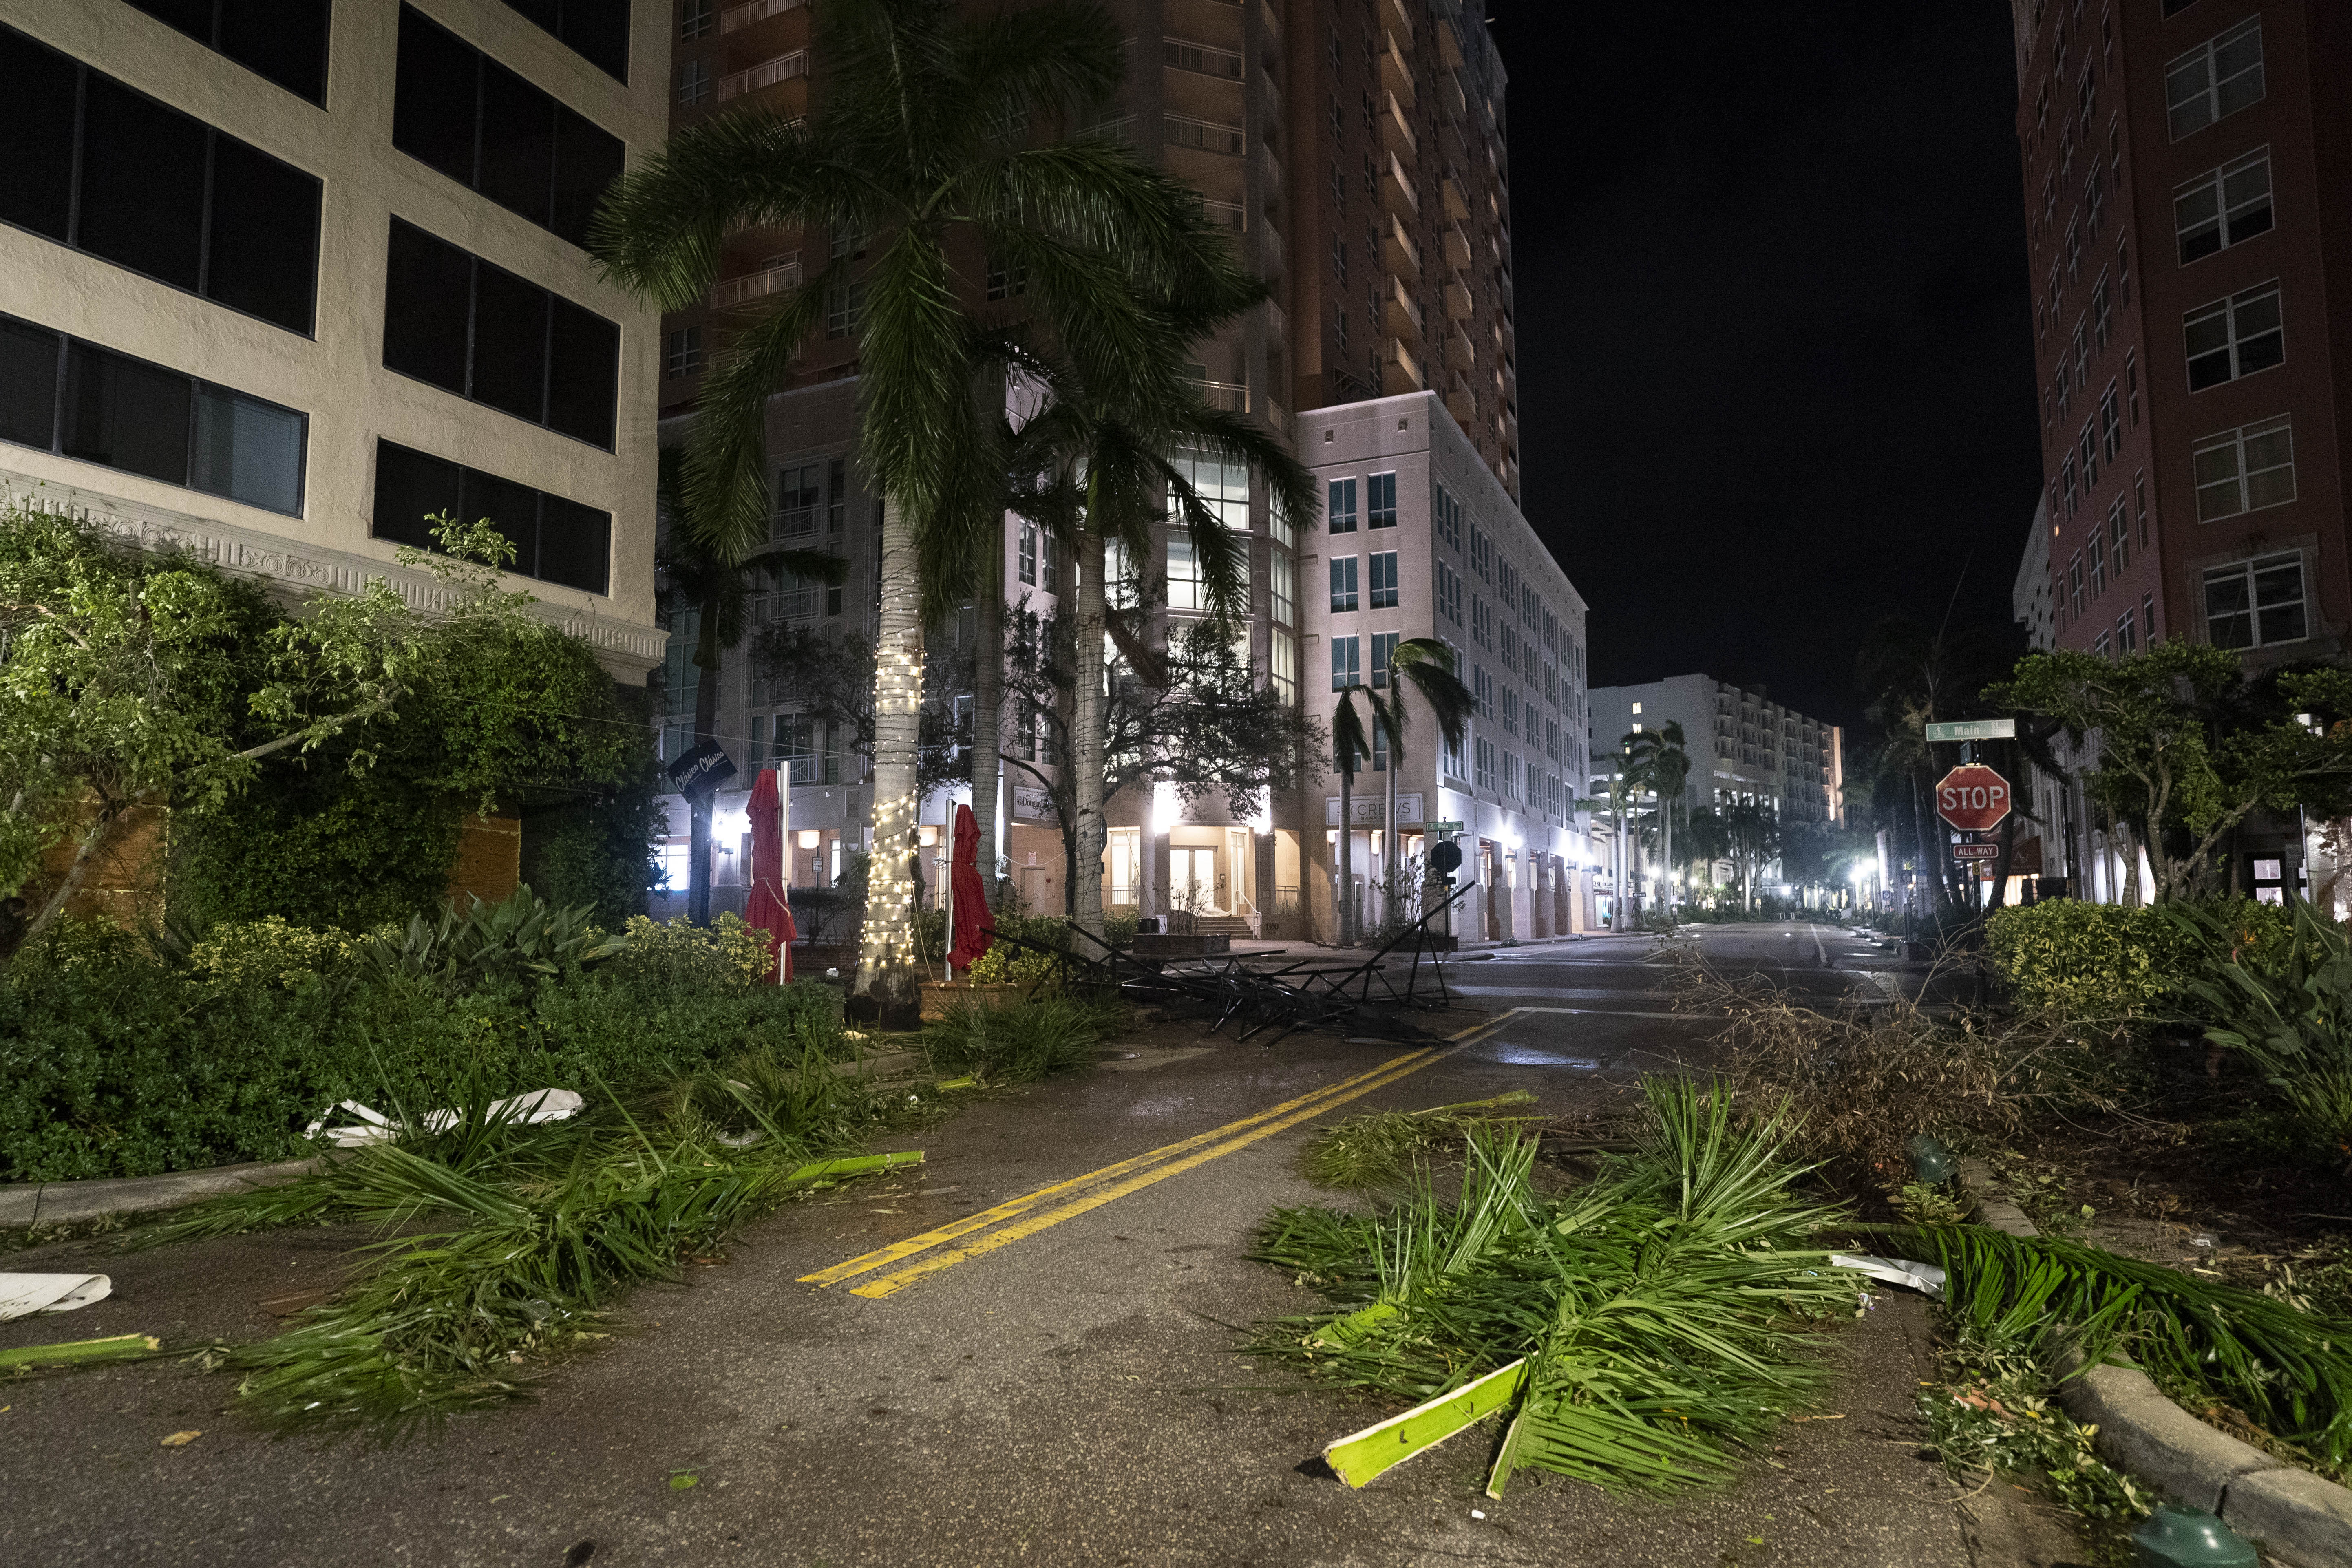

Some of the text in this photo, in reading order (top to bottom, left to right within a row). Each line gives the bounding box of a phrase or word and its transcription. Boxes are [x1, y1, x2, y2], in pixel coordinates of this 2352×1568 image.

[1954, 725, 1980, 736] Main
[699, 751, 724, 772] Clásico
[676, 764, 698, 792] Clásico
[1943, 786, 2004, 811] STOP
[1974, 864, 1979, 873] B
